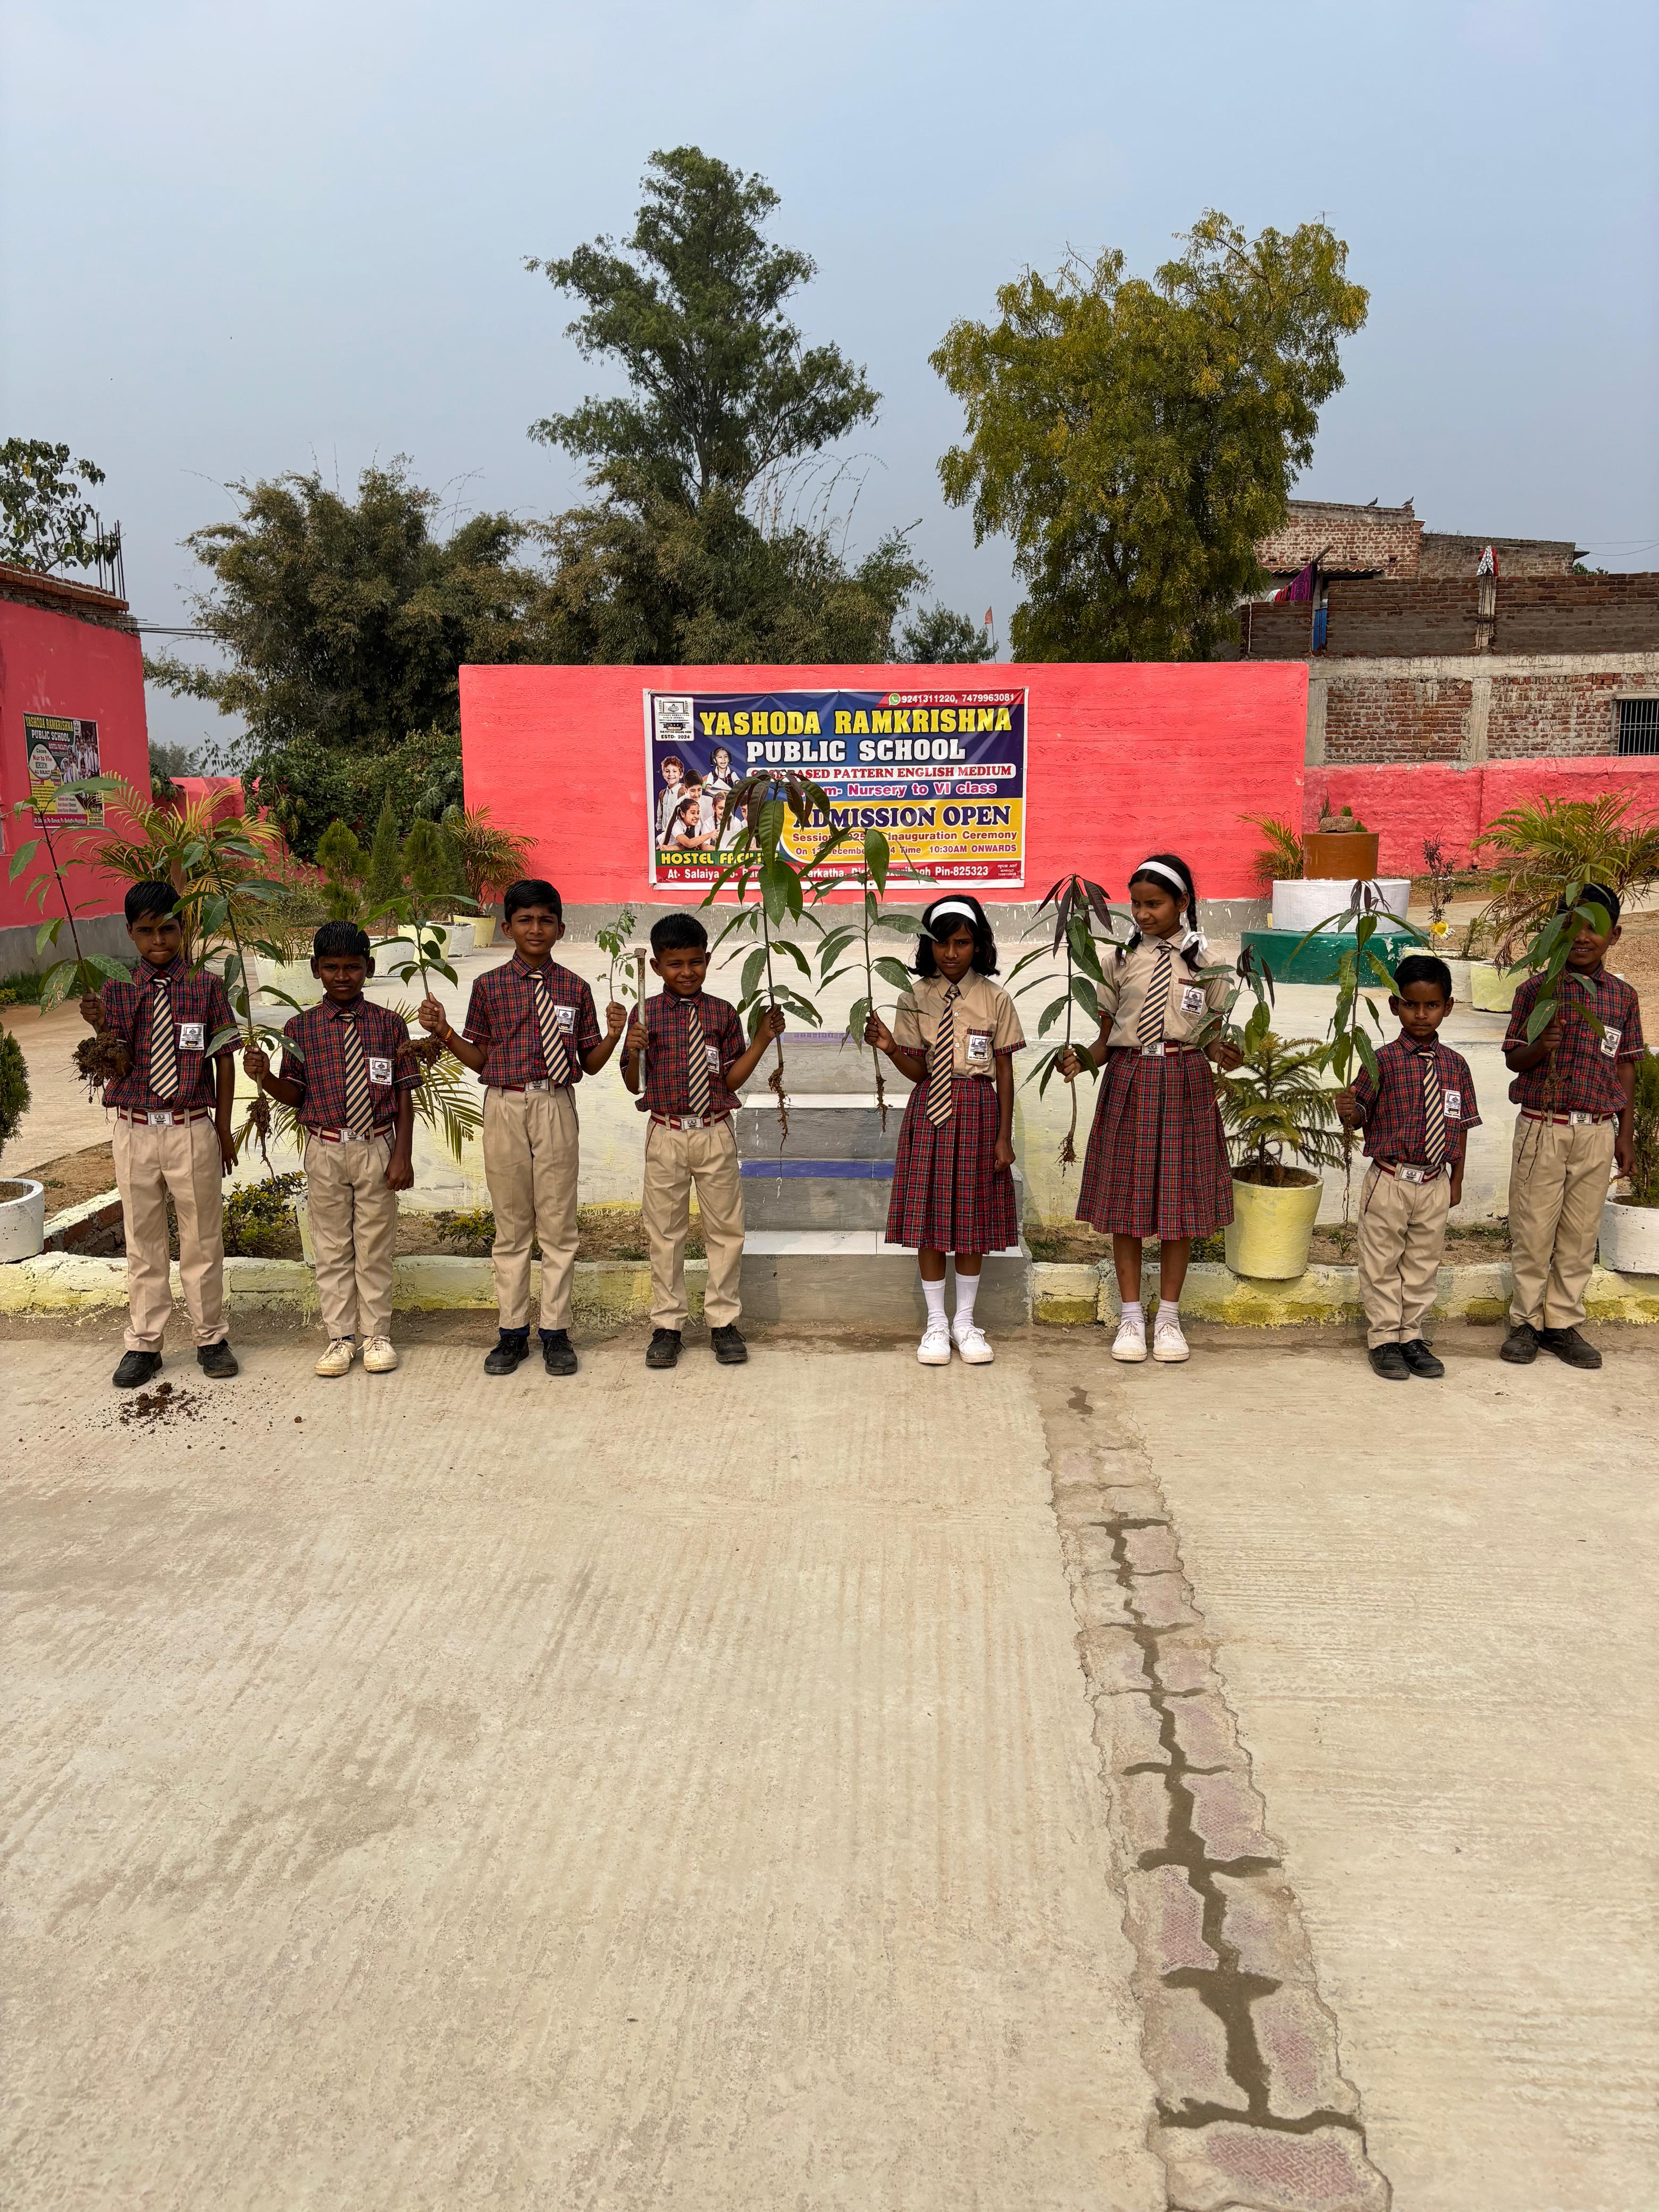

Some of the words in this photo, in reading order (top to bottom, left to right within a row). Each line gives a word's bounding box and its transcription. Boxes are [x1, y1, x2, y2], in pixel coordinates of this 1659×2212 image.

[901, 694, 958, 703] 9241311220,
[962, 693, 1014, 702] 7479963081
[25, 716, 45, 729] YASHODA
[700, 711, 821, 735] YASHODA
[835, 708, 1012, 734] RAMKRISHNA
[31, 729, 50, 740] PUBLIC
[51, 731, 70, 742] SCHOOL
[747, 740, 845, 762] PUBLIC
[859, 739, 965, 761] SCHOOL
[834, 768, 893, 778] PATTERN
[898, 767, 954, 778] ENGLISH
[958, 766, 1011, 776] MEDIUM
[849, 784, 906, 797] Nursery
[912, 784, 928, 794] to
[934, 783, 950, 794] VI
[957, 782, 996, 793] class
[943, 806, 1011, 826] OPEN
[793, 833, 832, 841] Sessio
[887, 831, 957, 841] Inauguration
[962, 831, 1017, 840] Ceremony
[661, 853, 714, 865] HOSTEL
[684, 869, 719, 879] Salaiya
[935, 866, 988, 876] Pin-825323
